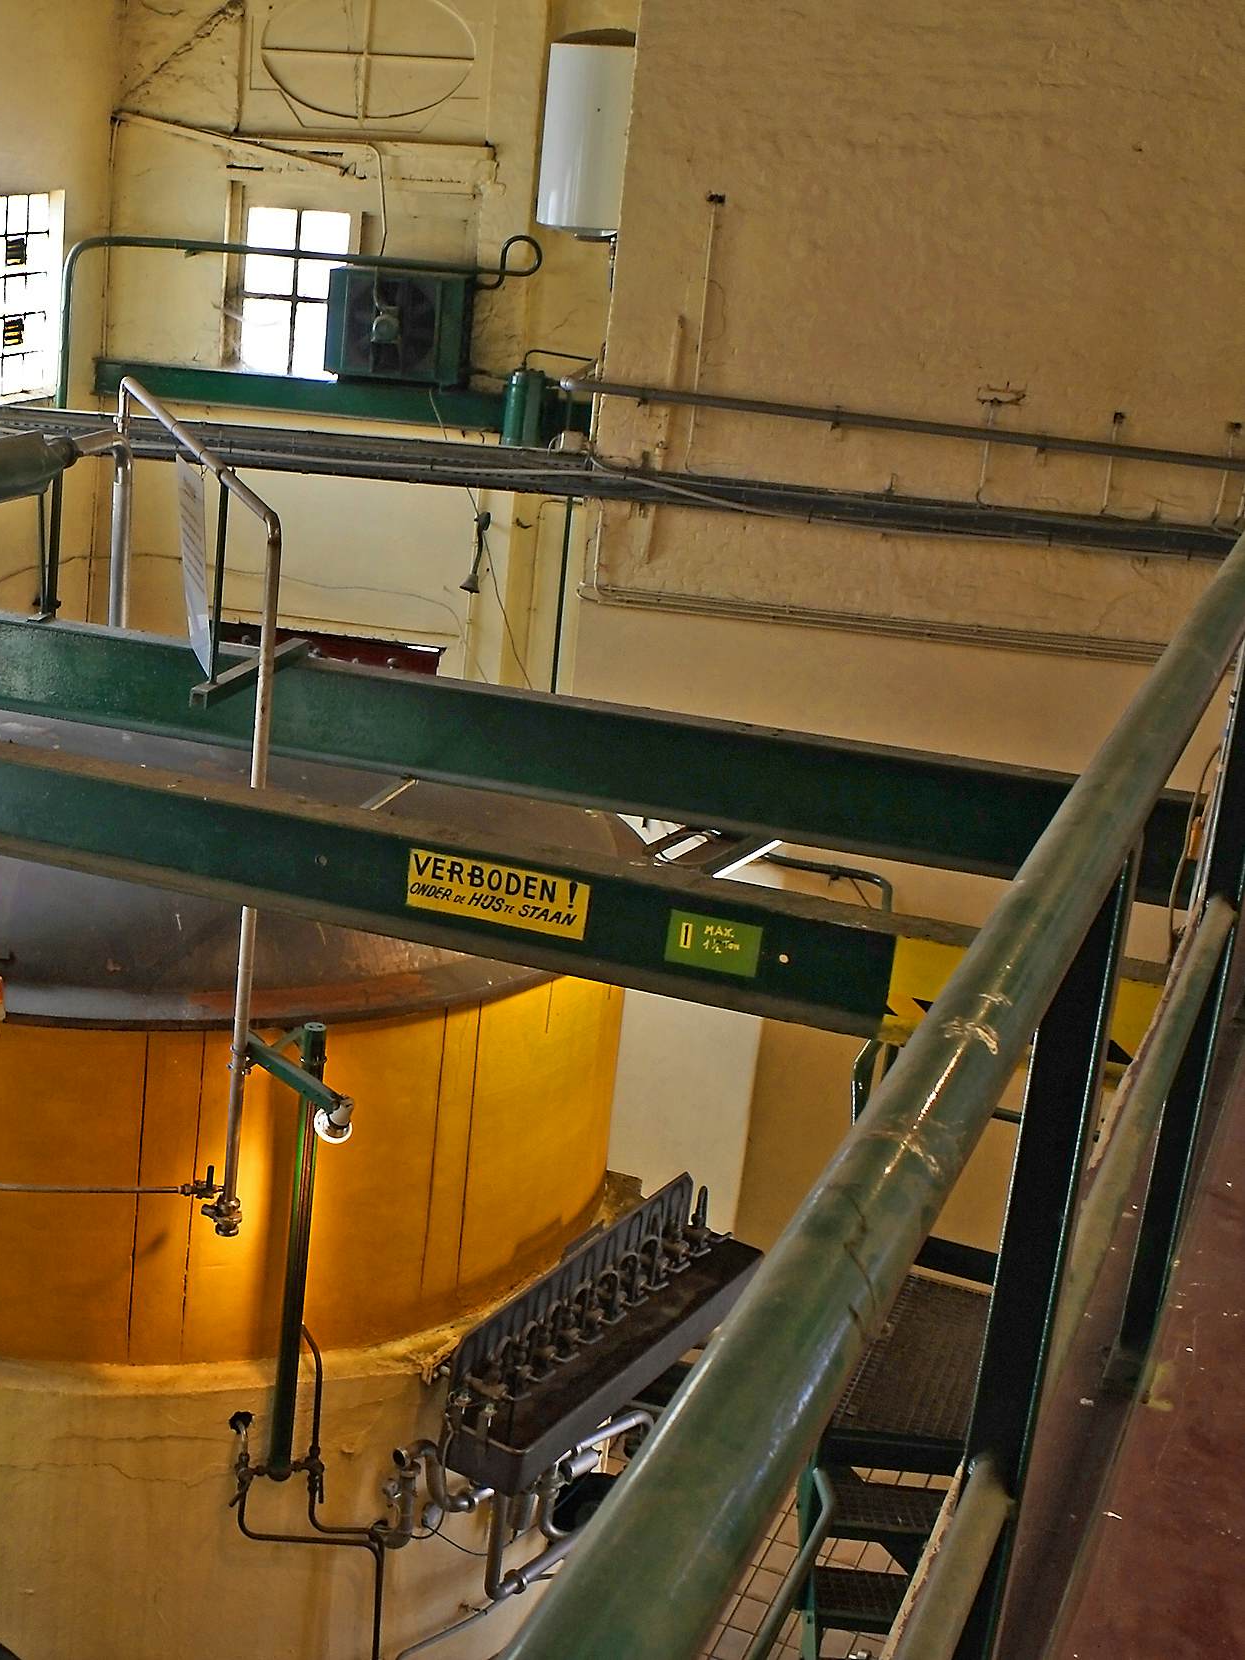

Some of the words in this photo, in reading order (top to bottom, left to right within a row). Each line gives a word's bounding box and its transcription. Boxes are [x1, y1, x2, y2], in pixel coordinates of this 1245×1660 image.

[413, 853, 557, 904] VERBODEN
[409, 882, 453, 901] ONDER
[518, 904, 577, 926] STAAN
